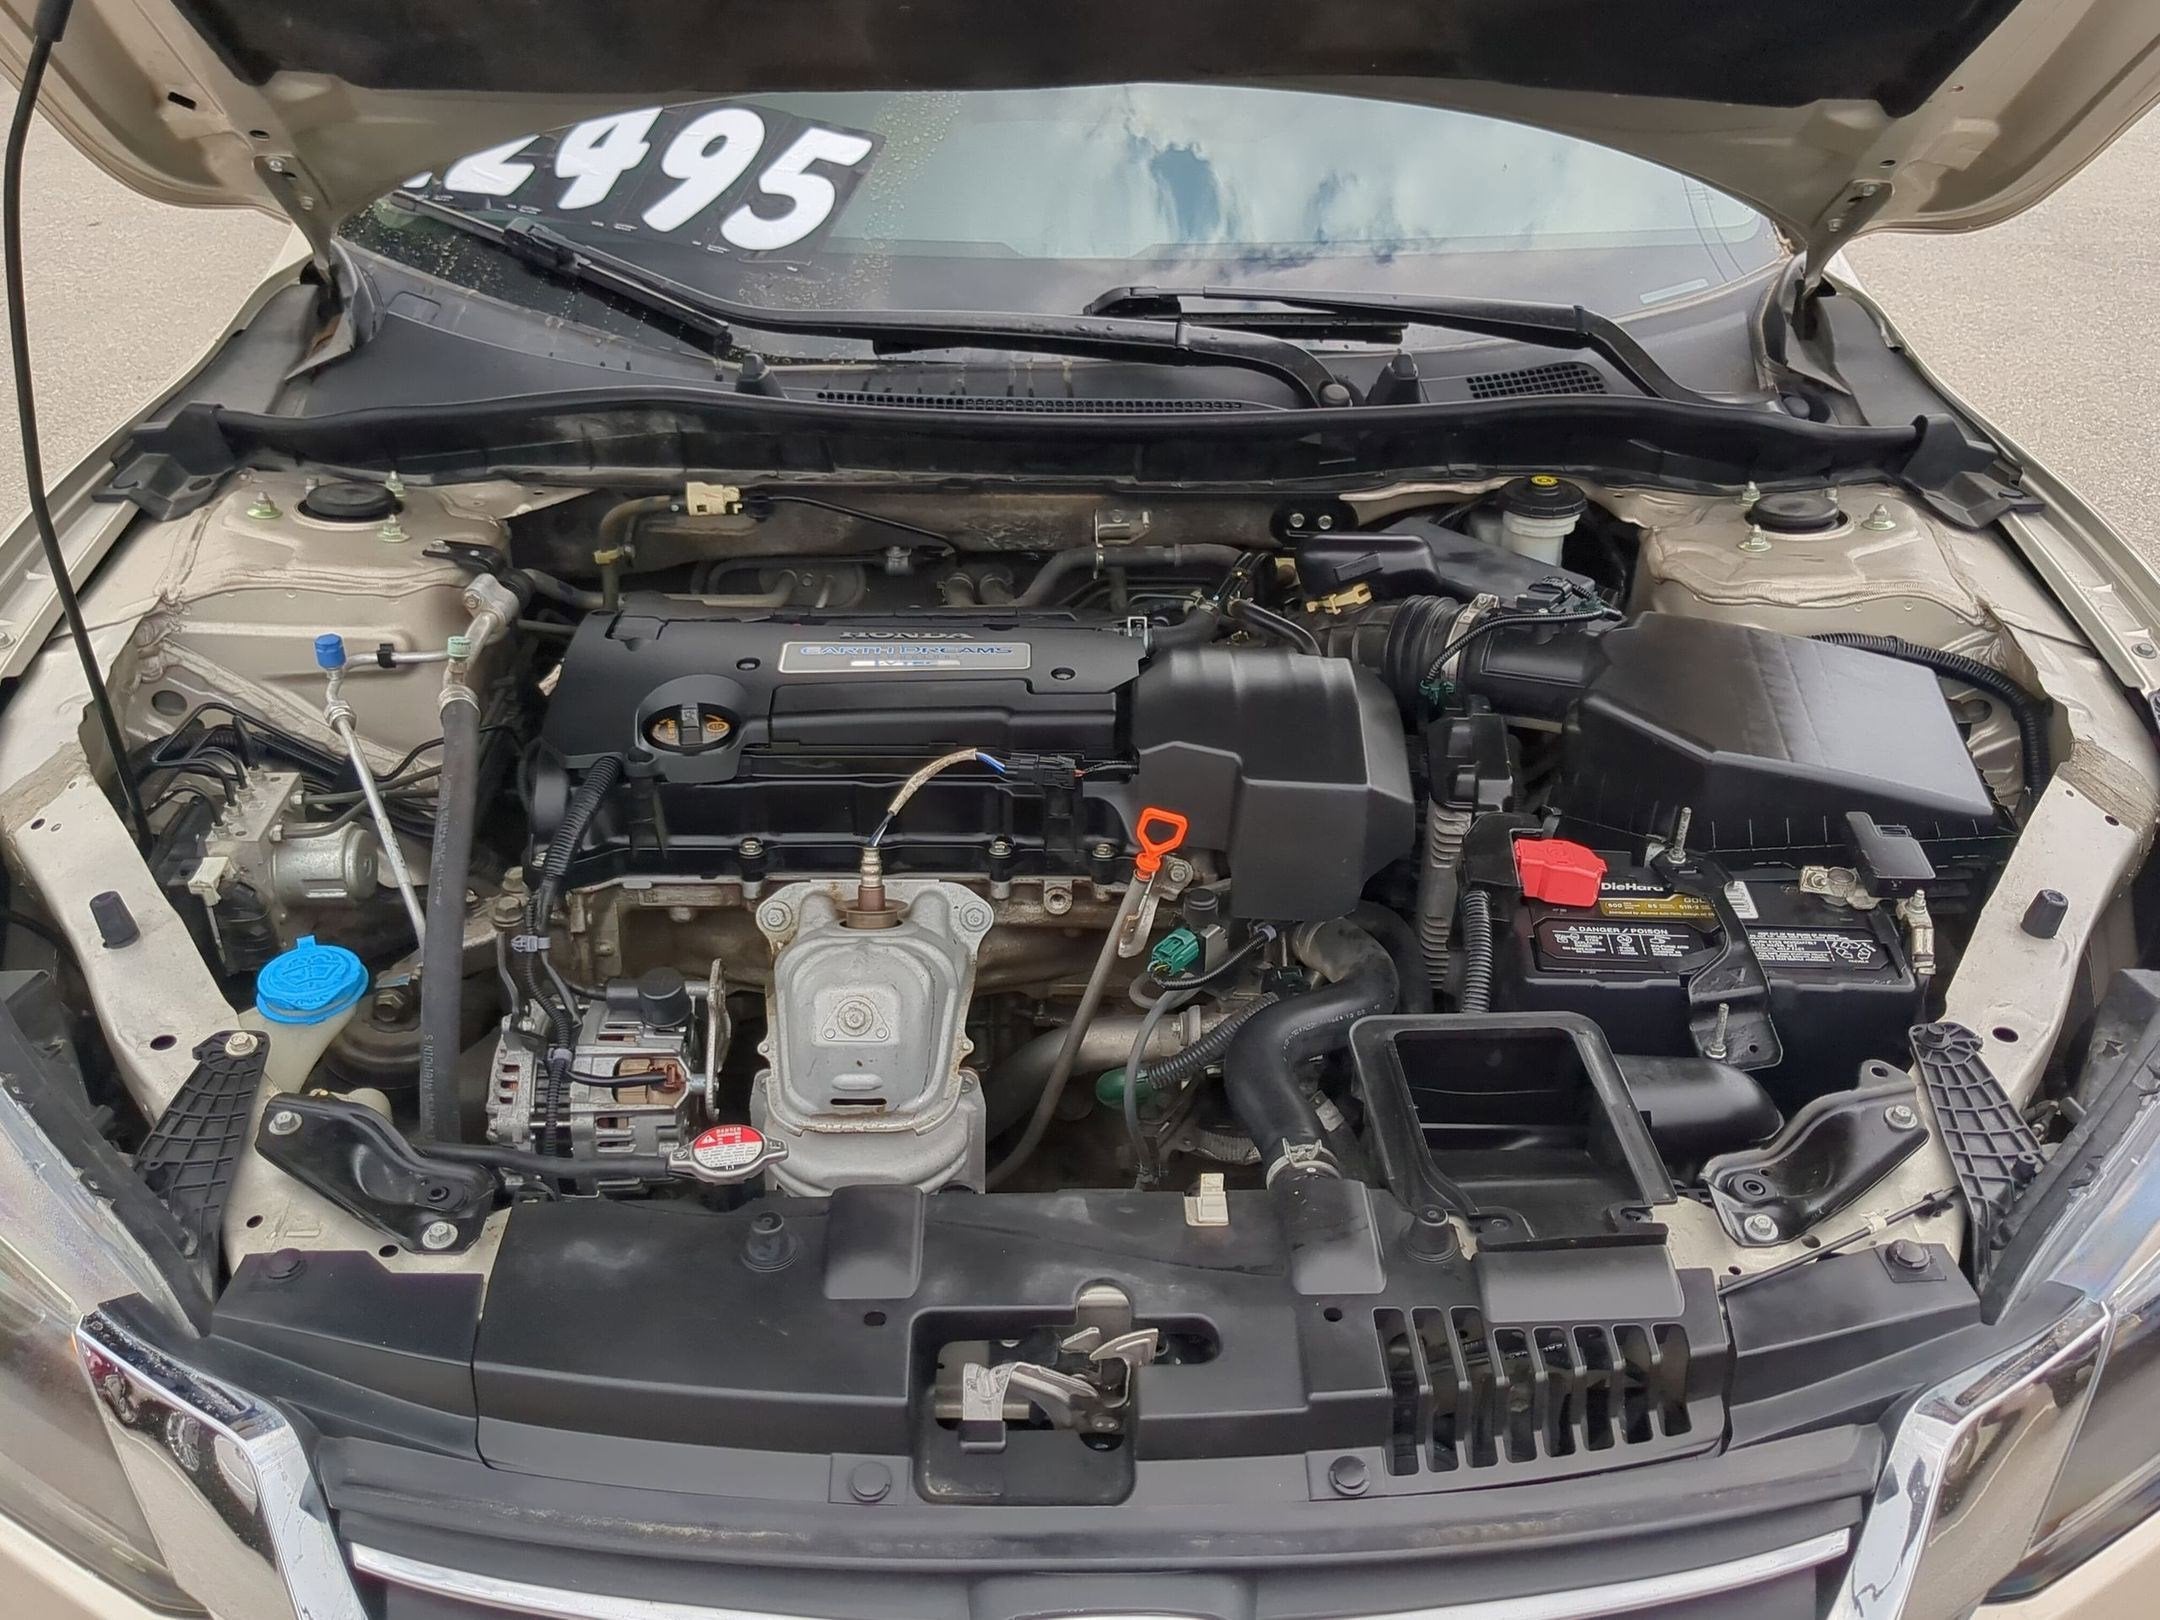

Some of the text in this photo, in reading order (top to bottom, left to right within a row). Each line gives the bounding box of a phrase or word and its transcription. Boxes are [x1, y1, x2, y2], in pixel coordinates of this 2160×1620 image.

[402, 107, 873, 250] 2495
[839, 631, 975, 639] HONDA
[800, 645, 1012, 656] EARTH DREAMS
[1578, 926, 1620, 934] DANGER
